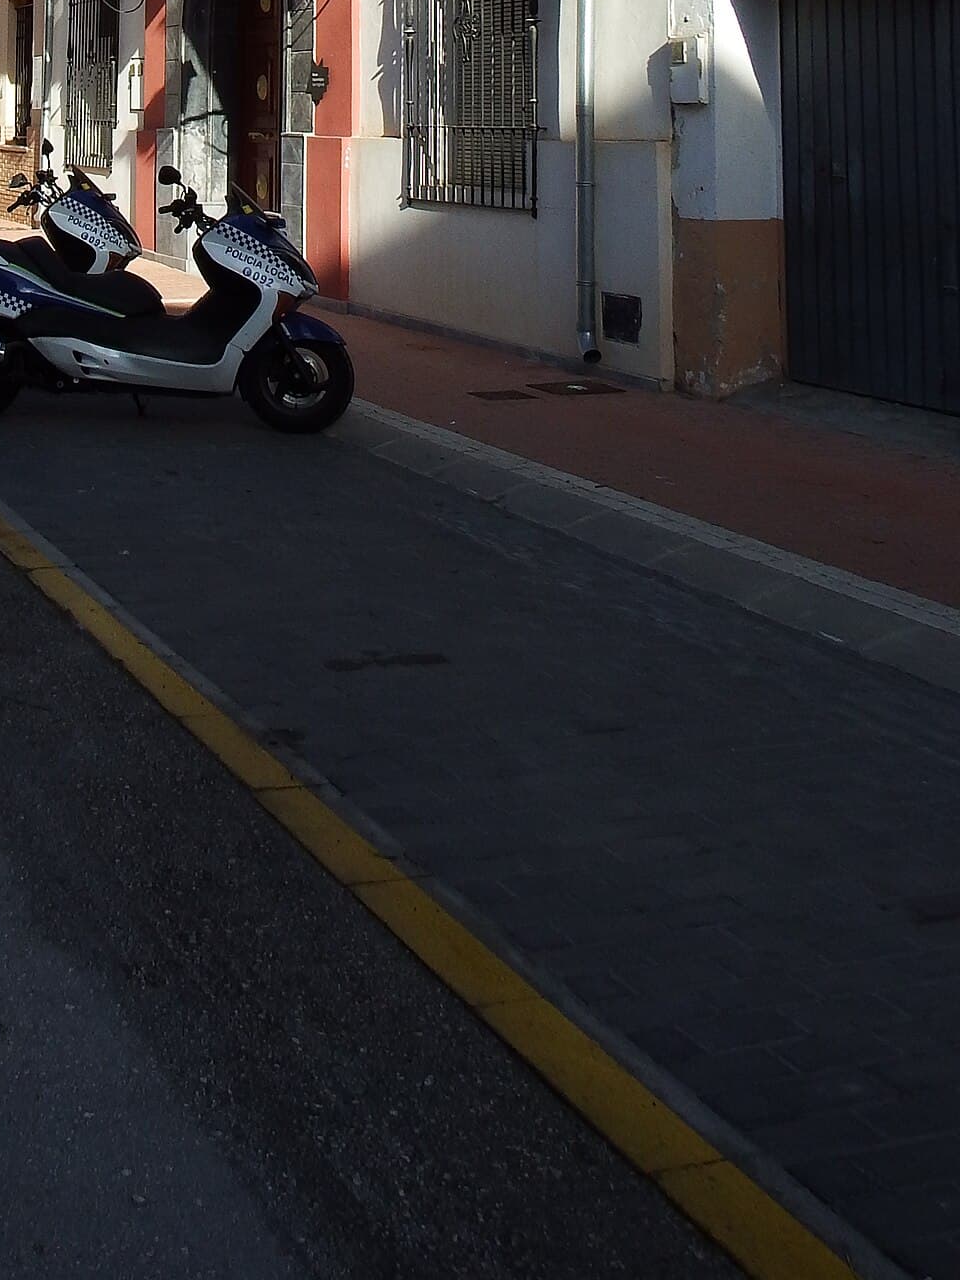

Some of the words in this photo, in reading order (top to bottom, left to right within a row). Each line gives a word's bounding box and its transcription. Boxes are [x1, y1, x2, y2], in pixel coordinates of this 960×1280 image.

[67, 214, 98, 234] POLICIA
[99, 231, 124, 249] LOCAL
[88, 236, 106, 250] 092
[225, 246, 263, 269] POLICIA
[264, 264, 295, 287] LOCAL
[252, 271, 274, 288] 092
